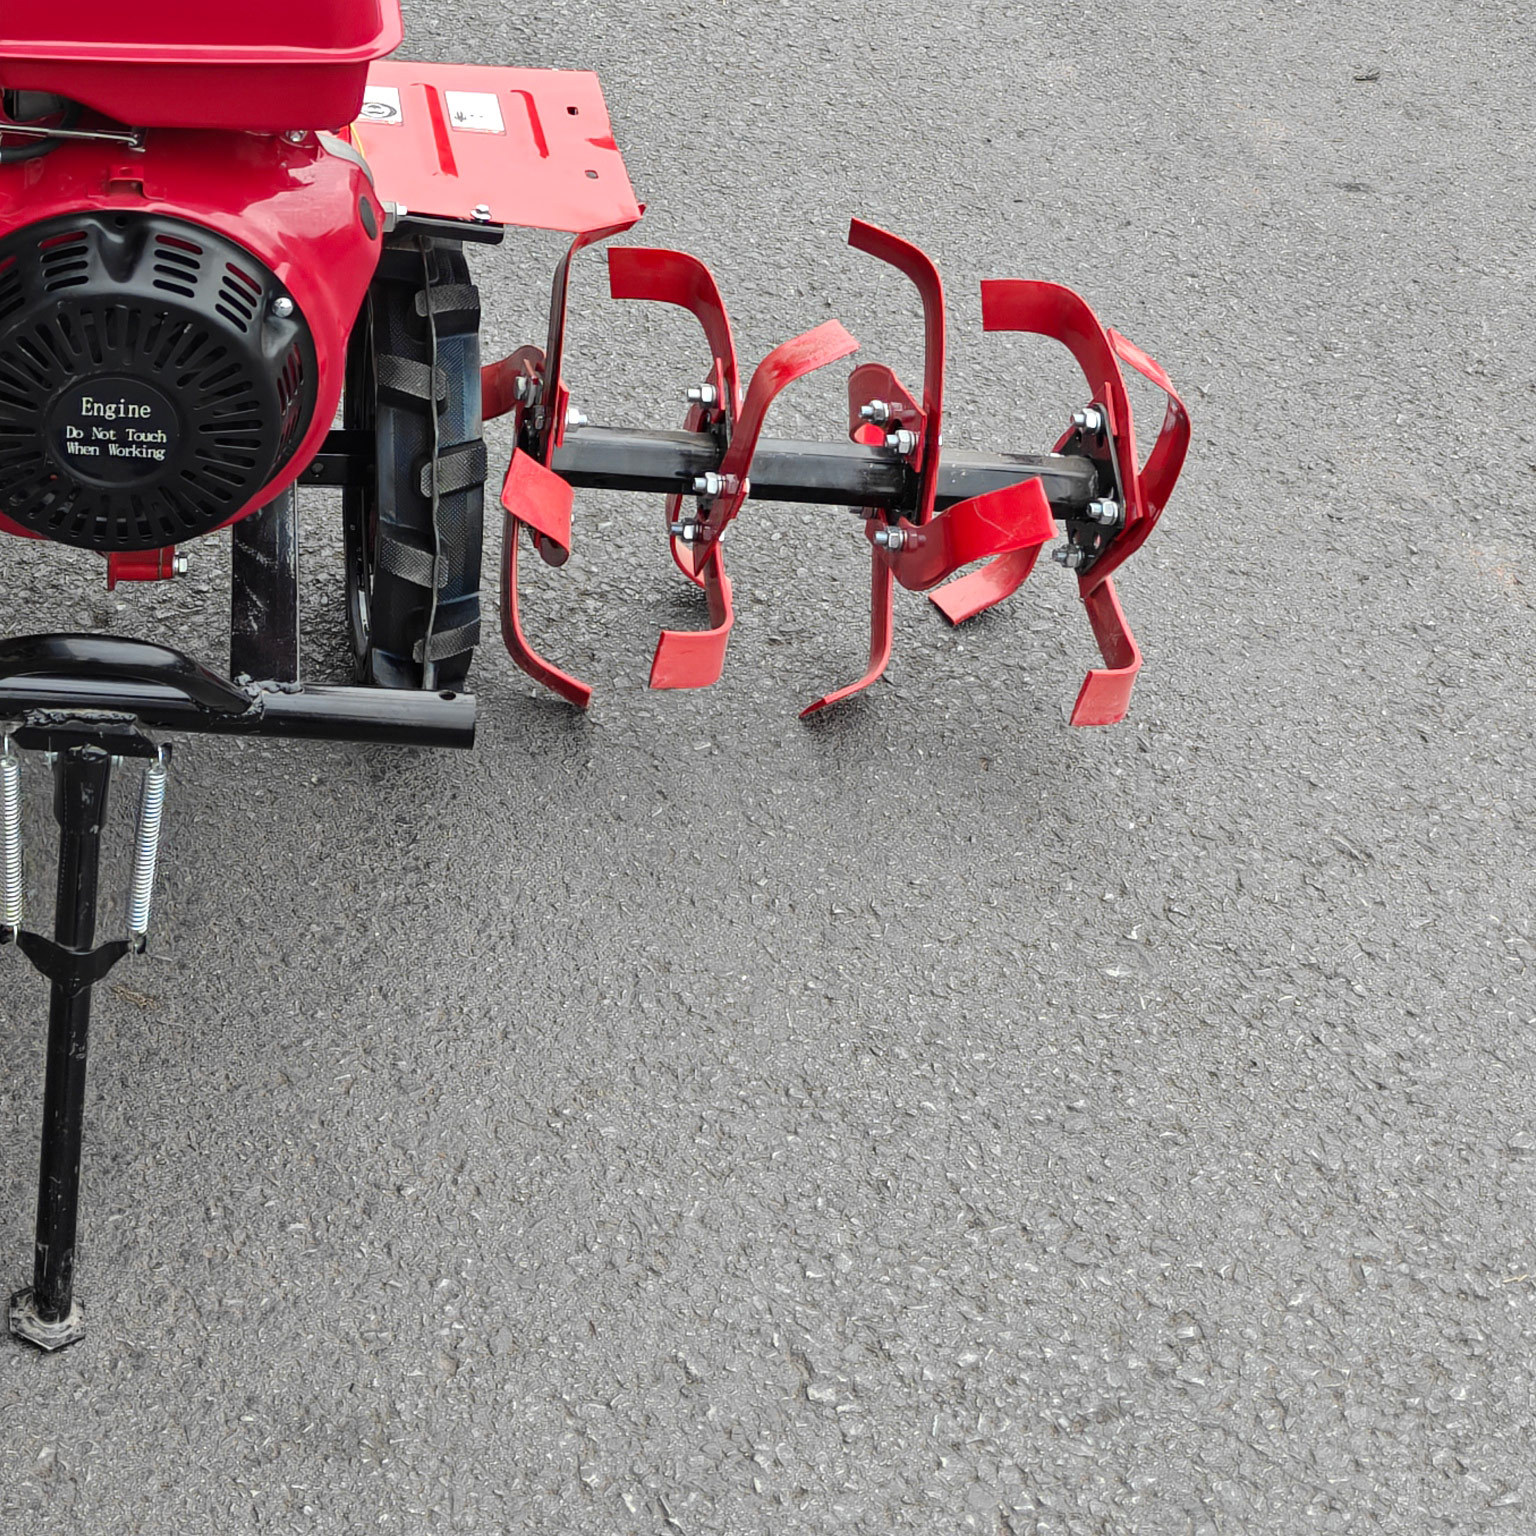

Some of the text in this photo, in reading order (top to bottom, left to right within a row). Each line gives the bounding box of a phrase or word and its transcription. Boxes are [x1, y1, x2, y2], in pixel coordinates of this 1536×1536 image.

[81, 396, 152, 420] Engine
[66, 425, 167, 443] Do Not Touch
[66, 441, 166, 462] When Working
